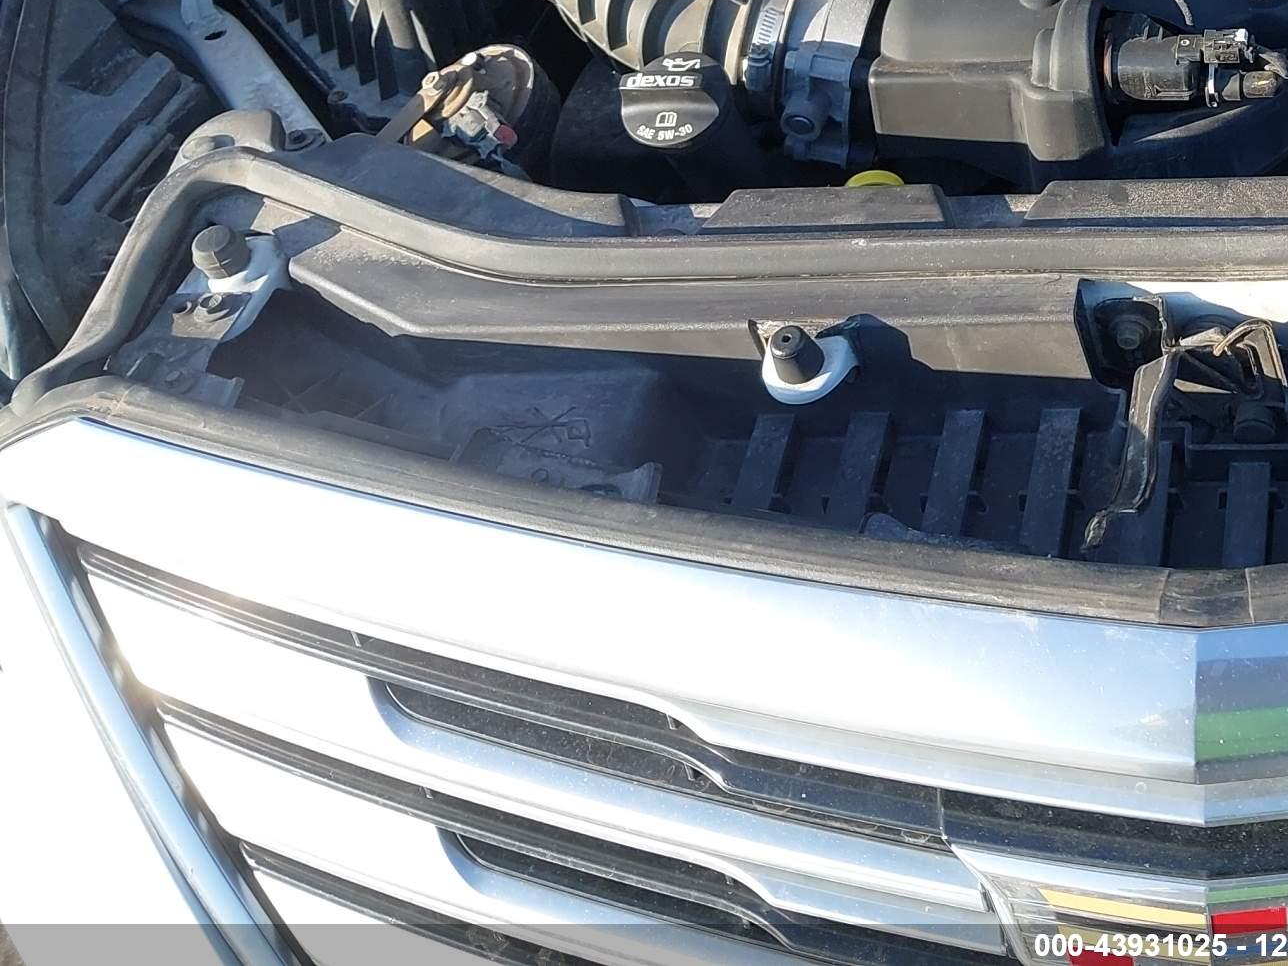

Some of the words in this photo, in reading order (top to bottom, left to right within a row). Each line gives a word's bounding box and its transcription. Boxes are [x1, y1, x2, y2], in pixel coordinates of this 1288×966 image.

[626, 73, 697, 87] dexos
[636, 124, 656, 140] SAE
[657, 123, 693, 141] 5W-30
